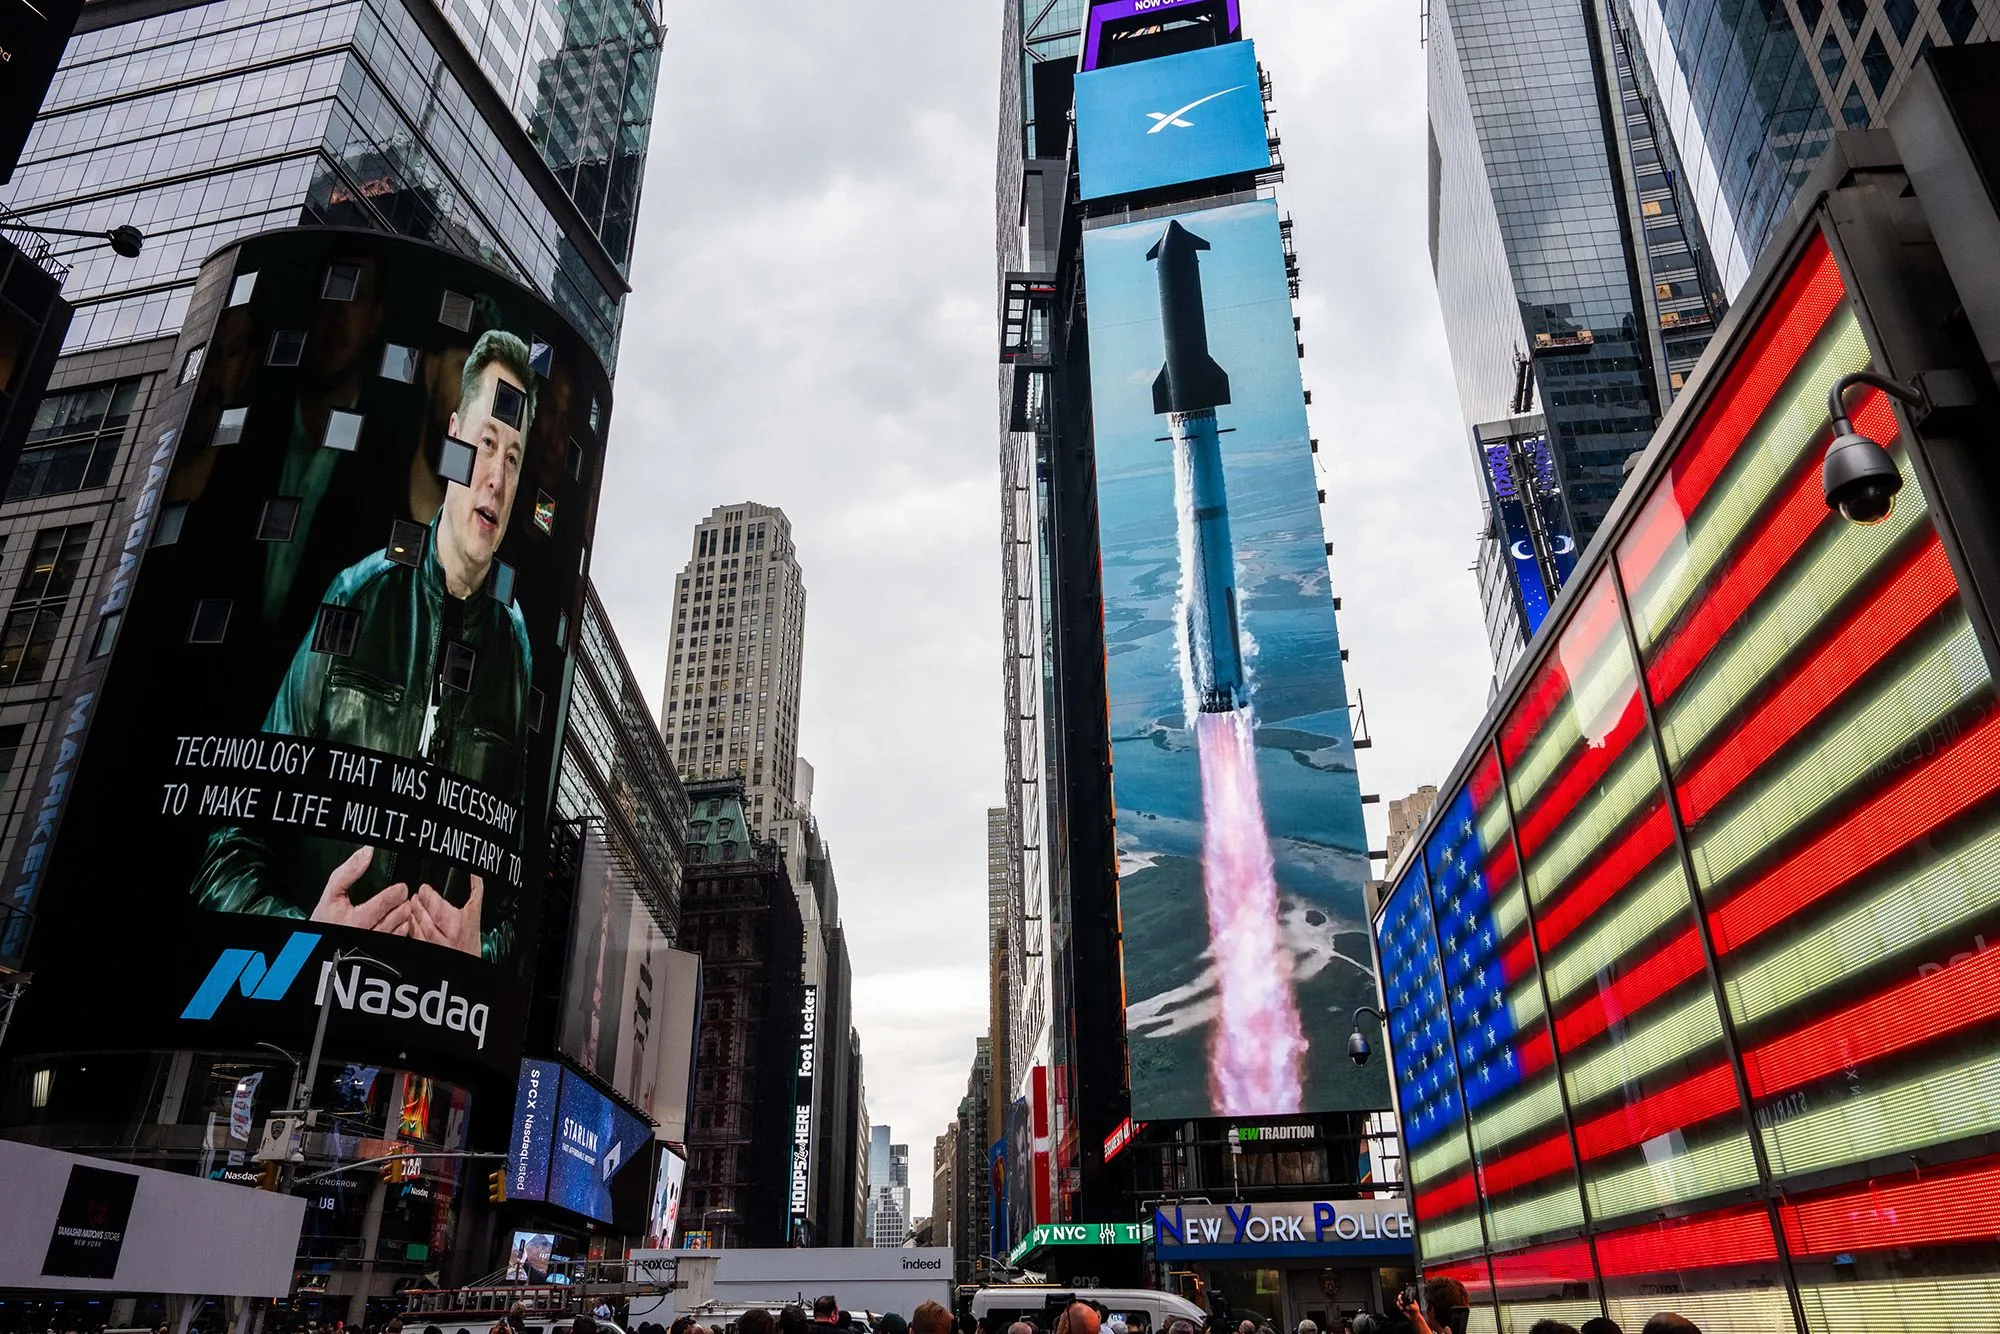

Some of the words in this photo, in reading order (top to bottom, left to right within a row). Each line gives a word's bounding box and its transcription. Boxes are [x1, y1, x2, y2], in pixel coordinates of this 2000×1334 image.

[99, 428, 177, 616] NASDAQ
[173, 736, 315, 775] TECHNOLOGY
[328, 750, 382, 787] THAT
[391, 763, 428, 800] WAS
[437, 777, 517, 834] NECESSARY
[161, 783, 189, 815] TO
[199, 784, 261, 818] MAKE
[272, 790, 332, 827] LIFE
[341, 801, 504, 874] MULTI-PLANETARY
[509, 853, 523, 888] TO.
[314, 960, 489, 1050] Nasdaq
[798, 1043, 813, 1077] Foot
[526, 1069, 540, 1109] SPCX
[563, 1117, 599, 1153] STARLINK
[795, 1105, 810, 1144] HERE
[1239, 1125, 1314, 1140] EWTRADITION
[791, 1161, 808, 1213] HOOPS
[1053, 1227, 1087, 1240] NYC
[1155, 1205, 1222, 1246] NEW
[1225, 1203, 1306, 1244] YORK
[1313, 1202, 1412, 1242] POLICE
[901, 1257, 941, 1270] indeed
